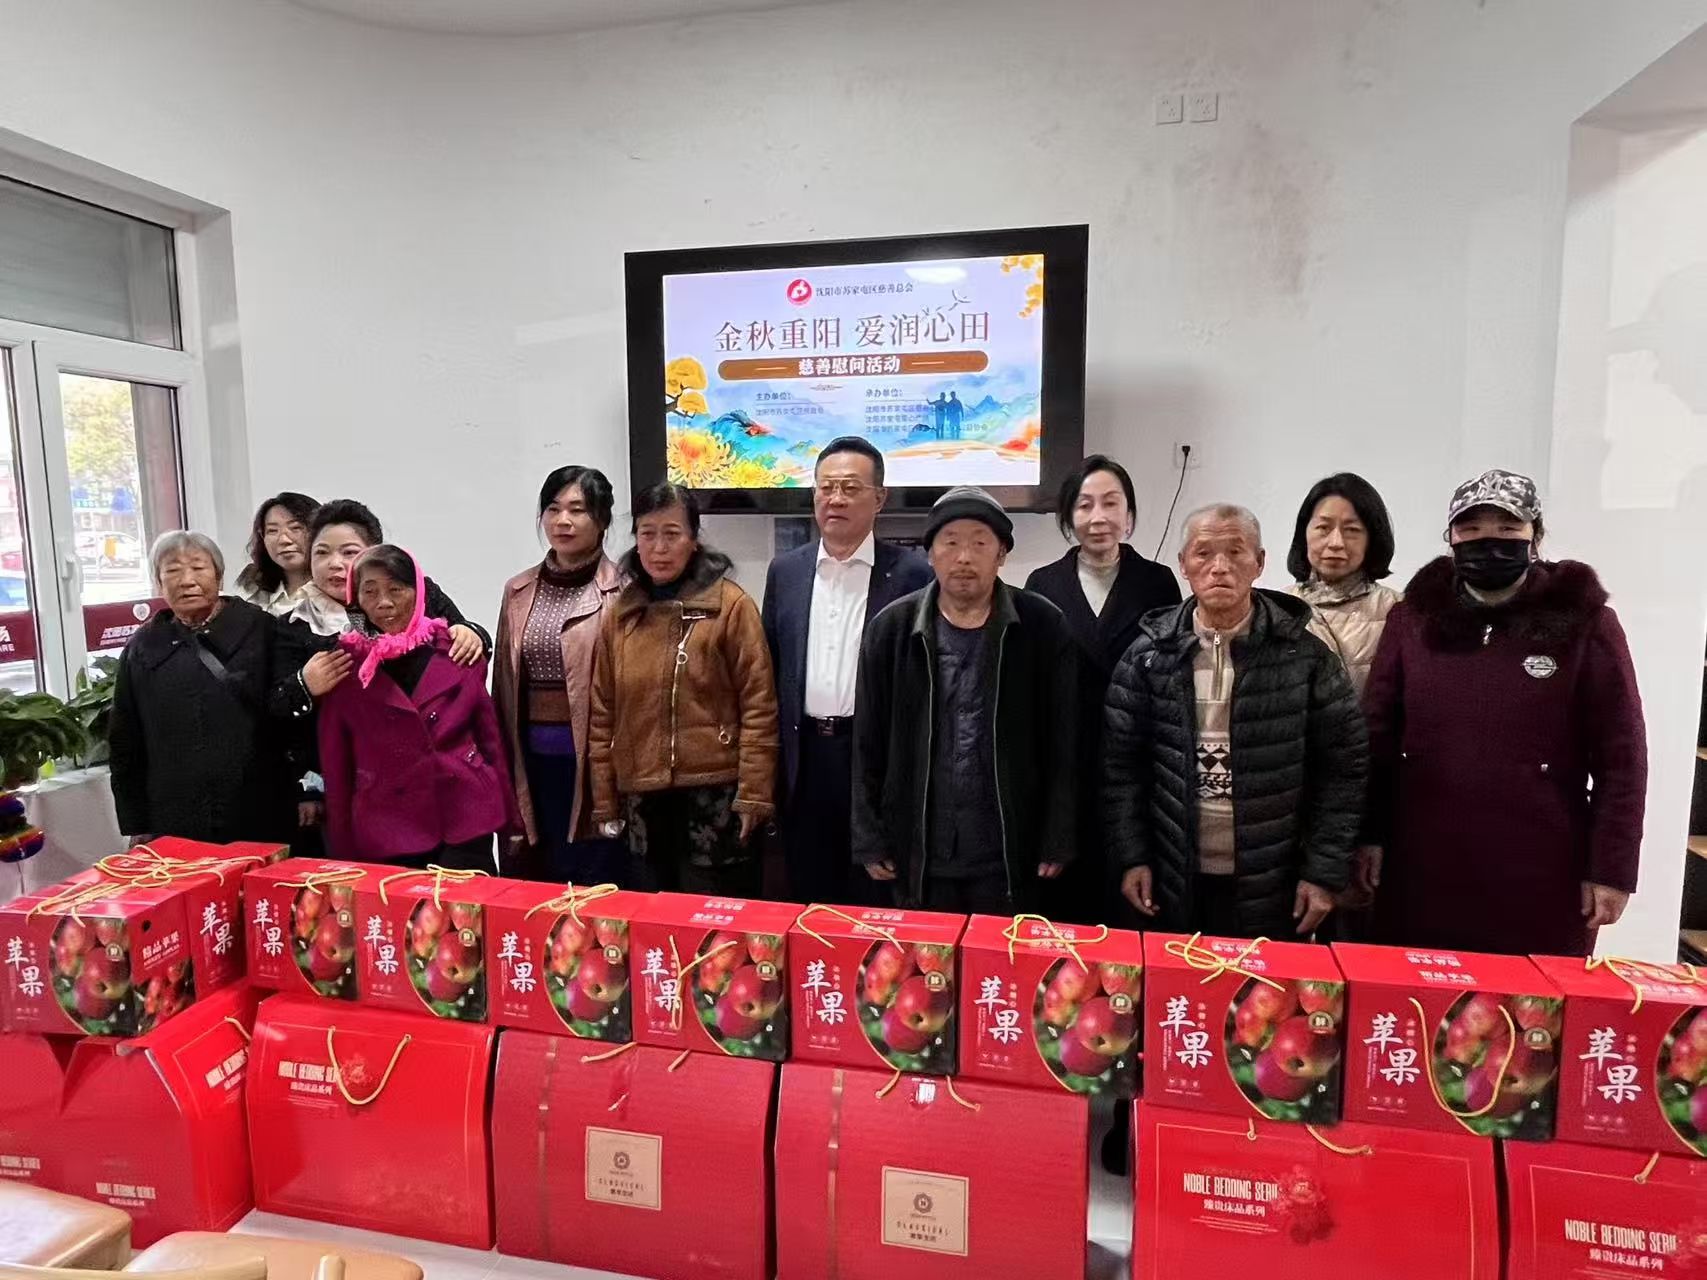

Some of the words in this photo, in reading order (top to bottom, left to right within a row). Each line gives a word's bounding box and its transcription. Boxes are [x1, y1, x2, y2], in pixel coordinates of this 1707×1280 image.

[816, 283, 913, 297] 沈阳市苏家屯区慈善总会
[714, 318, 841, 352] 金秋重阳
[855, 311, 990, 348] 爱润心田
[798, 355, 901, 376] 慈善慰问活动
[200, 902, 234, 955] 苹果
[253, 899, 285, 957] 苹果
[363, 915, 399, 975] 苹果
[5, 936, 44, 997] 苹果
[497, 931, 537, 993] 苹果
[641, 947, 682, 1011] 苹果
[801, 959, 848, 1025] 苹果
[974, 975, 1023, 1044] 苹果
[1158, 995, 1213, 1068] 苹果
[1363, 1012, 1421, 1086] 苹果
[1579, 1027, 1642, 1104] 苹果
[1183, 1173, 1211, 1195] NOBLE
[1214, 1177, 1252, 1200] BEDDING
[1565, 1218, 1598, 1245] NOBLE
[1601, 1224, 1647, 1252] BEDDING
